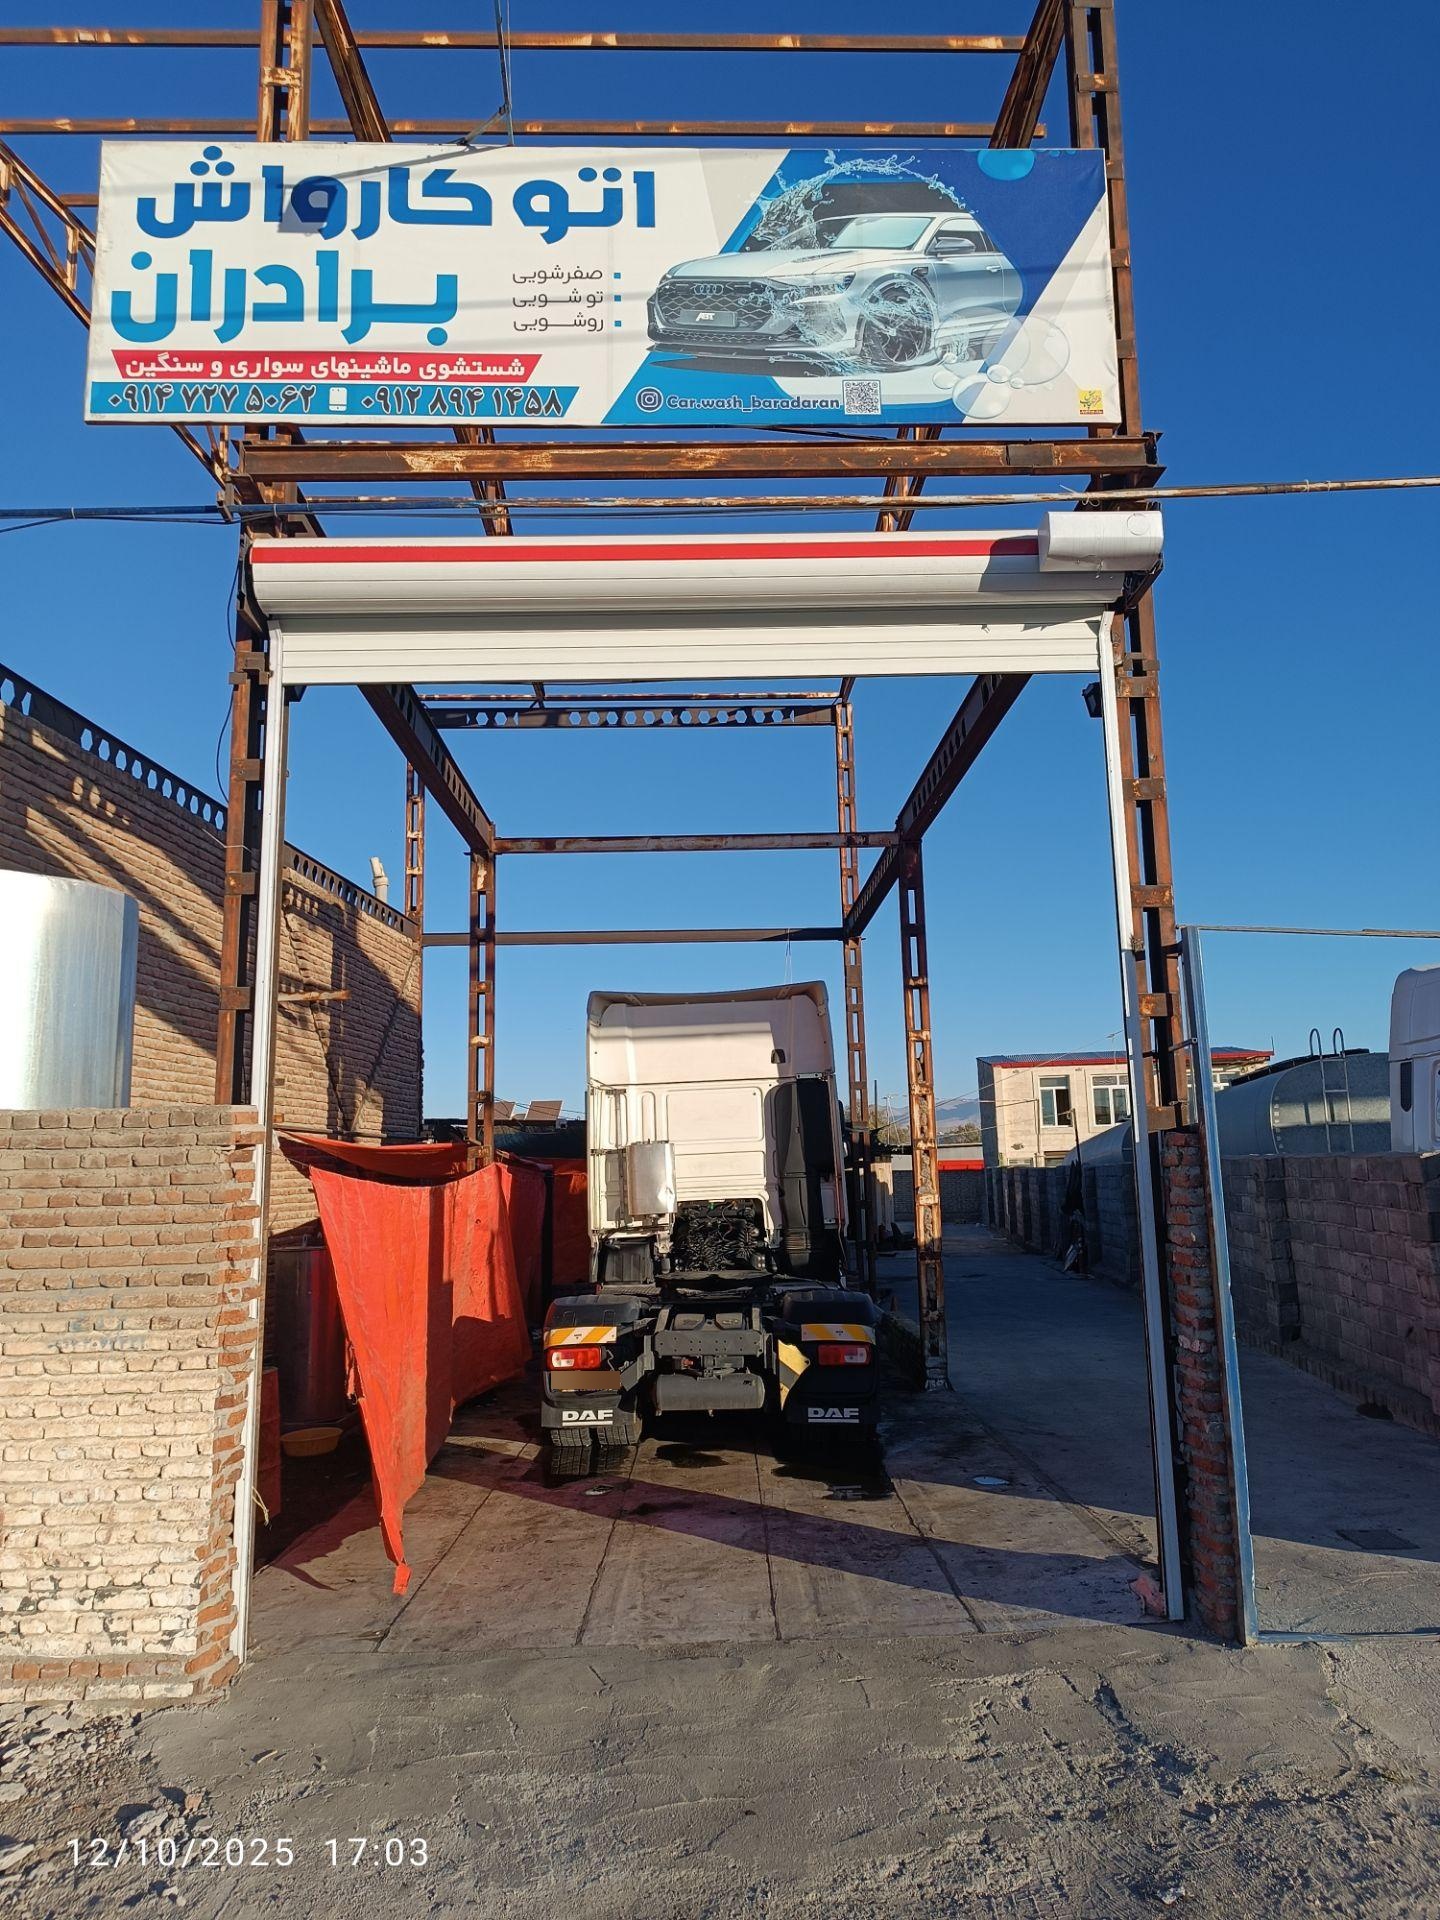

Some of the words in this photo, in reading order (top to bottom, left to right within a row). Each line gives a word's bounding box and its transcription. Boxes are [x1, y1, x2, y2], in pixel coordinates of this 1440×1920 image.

[136, 145, 493, 241] کارواش
[513, 167, 656, 245] اتو
[512, 264, 603, 285] صفرشویی
[110, 248, 458, 347] برادران
[125, 352, 204, 377] سنگین
[210, 359, 223, 378] و
[230, 356, 304, 378] سواری
[310, 356, 412, 379] ماشینهای
[419, 357, 526, 380] شستشوی
[108, 383, 174, 412] ۰۹۱۴
[180, 384, 240, 413] ۷۲۷
[361, 386, 422, 415] ۰۹۱۲
[428, 386, 485, 415] ۸۹۴
[492, 387, 563, 416] ۱۴۵۸
[666, 394, 840, 412] Car.wash_baradaran
[562, 1409, 614, 1421] DAF
[807, 1407, 860, 1419] DAF
